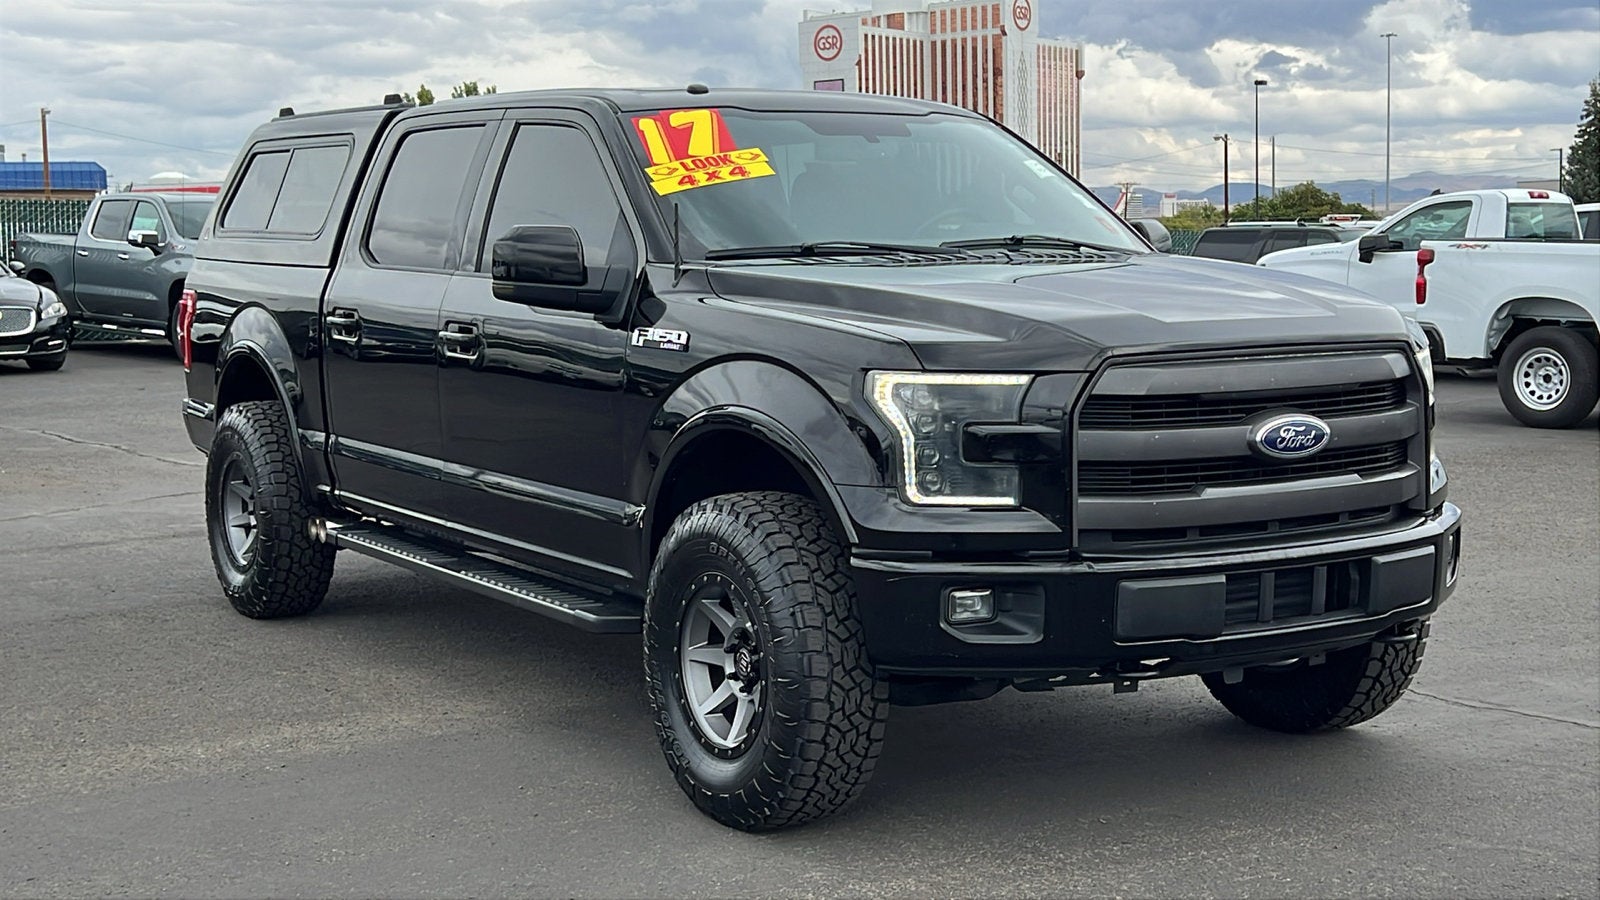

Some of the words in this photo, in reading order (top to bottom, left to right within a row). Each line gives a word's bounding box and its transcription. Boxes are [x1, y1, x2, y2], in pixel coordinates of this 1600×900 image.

[818, 35, 839, 51] GSR
[638, 109, 720, 164] 17
[680, 154, 734, 172] LOOK
[1276, 425, 1316, 450] Ford
